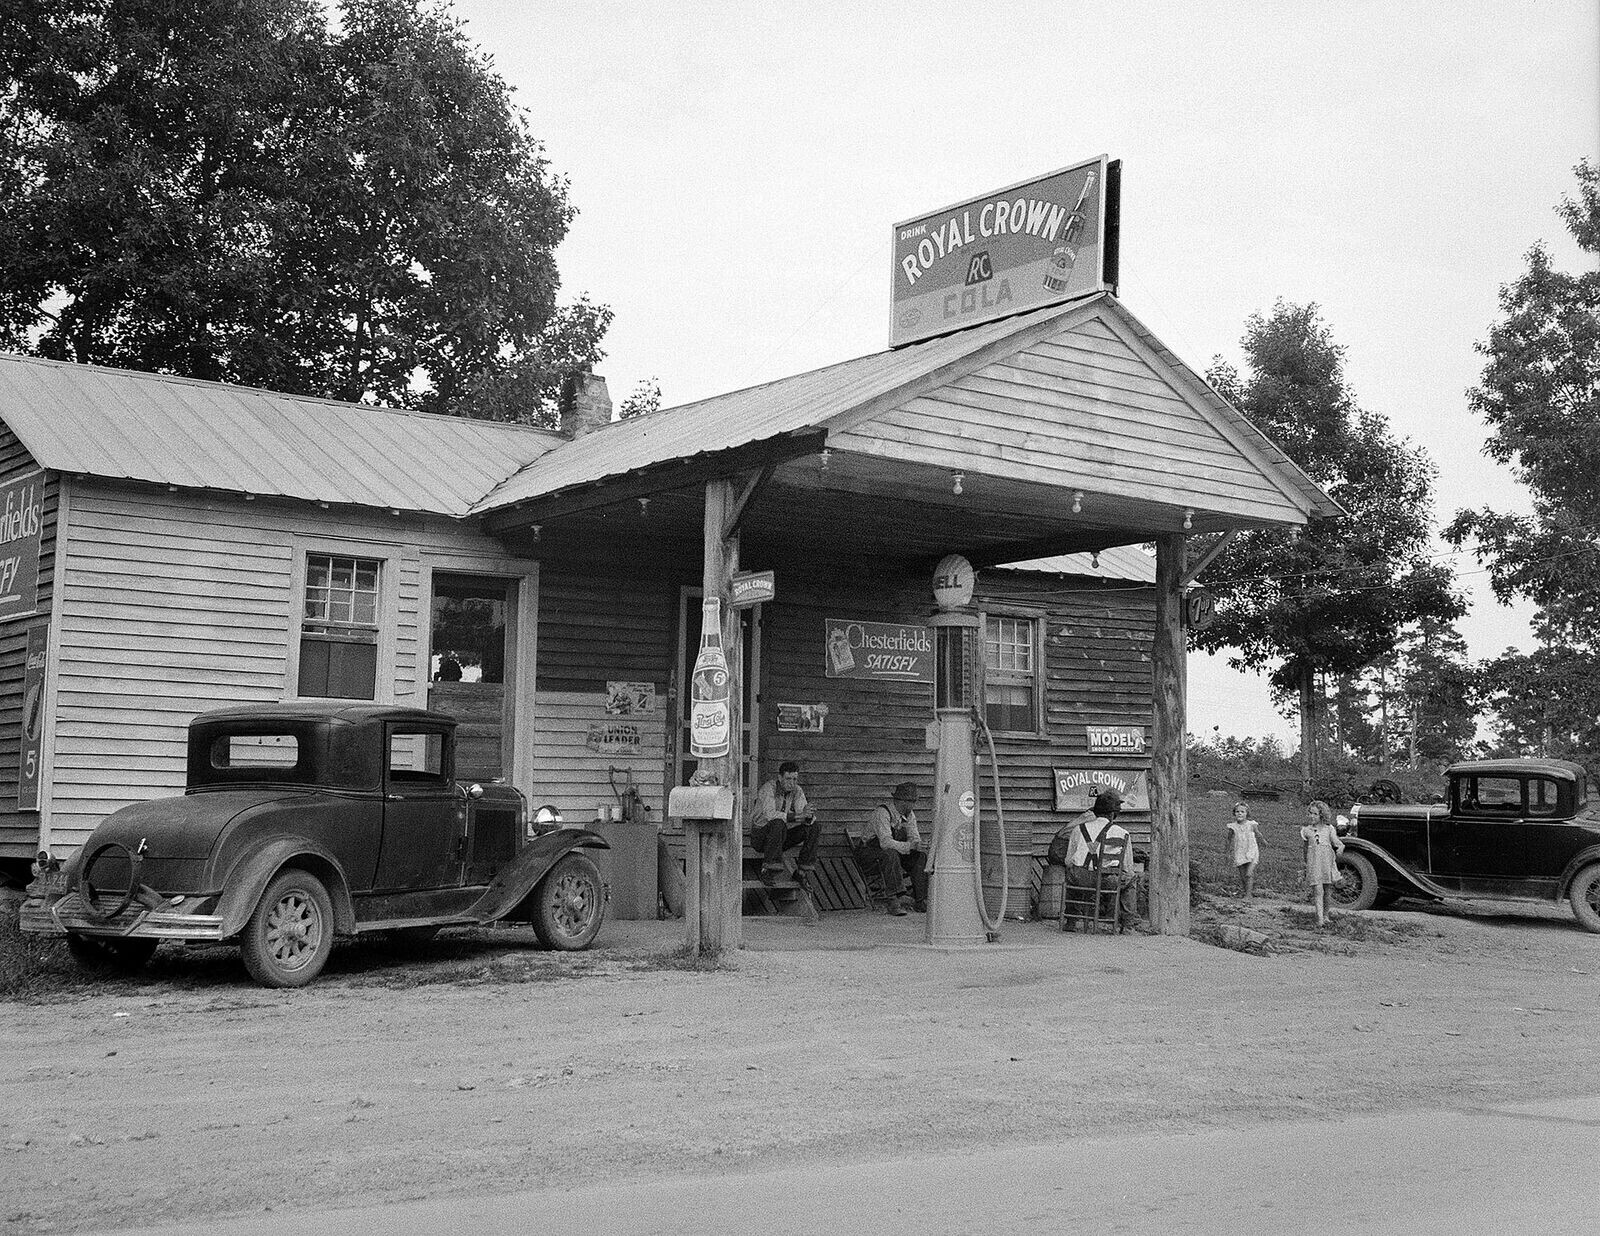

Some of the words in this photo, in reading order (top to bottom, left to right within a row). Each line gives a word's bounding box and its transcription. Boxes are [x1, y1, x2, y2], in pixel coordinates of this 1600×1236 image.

[901, 225, 927, 240] DRINK
[902, 211, 975, 285] ROYAL
[979, 198, 1066, 242] CROWN
[967, 253, 991, 283] RC
[943, 278, 1013, 318] COLA
[846, 624, 931, 652] Chesterfields
[864, 653, 918, 671] SATISFY
[603, 734, 641, 745] LEADER
[607, 725, 638, 735] UNION
[1090, 732, 1134, 746] MODEL
[1060, 771, 1091, 793] ROYAL
[1092, 770, 1126, 793] CROWN
